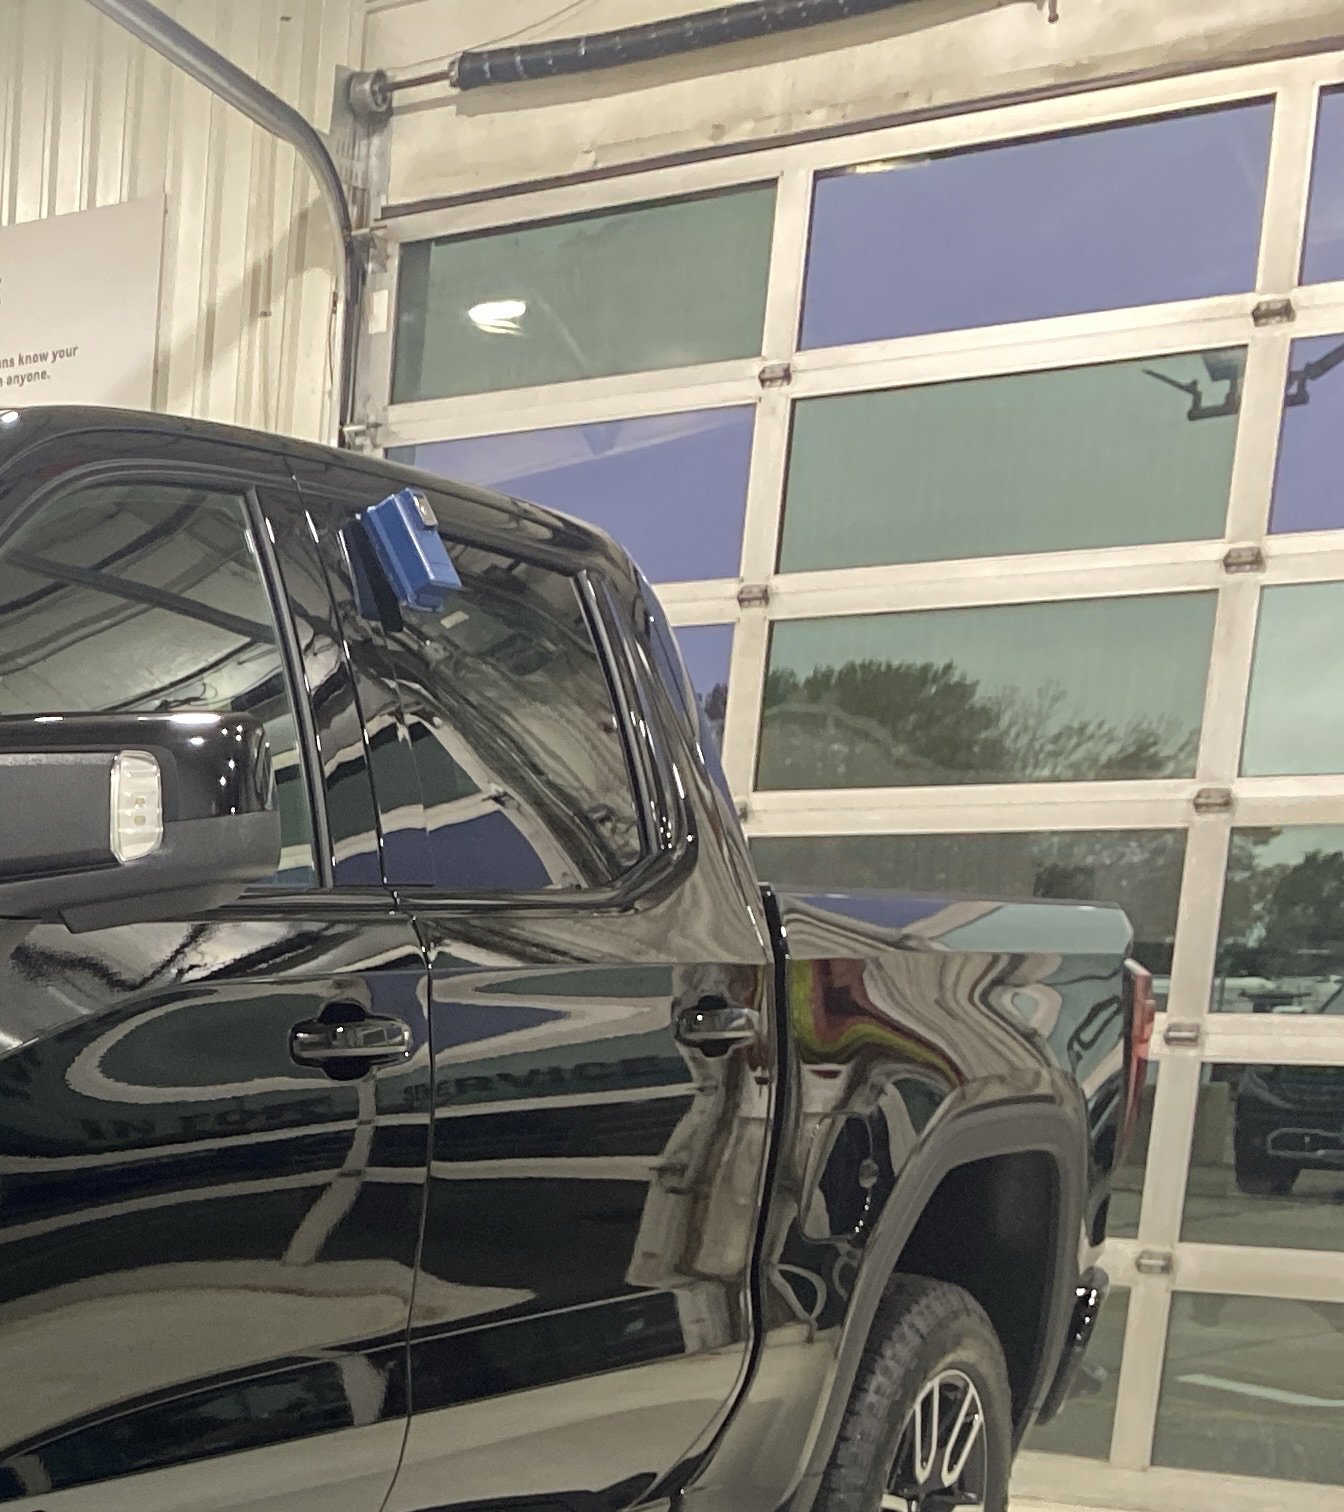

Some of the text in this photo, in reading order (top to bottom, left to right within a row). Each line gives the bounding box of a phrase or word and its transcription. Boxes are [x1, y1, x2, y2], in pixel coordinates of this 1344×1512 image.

[18, 352, 48, 366] know
[51, 346, 79, 363] your
[6, 370, 51, 387] anyone.
